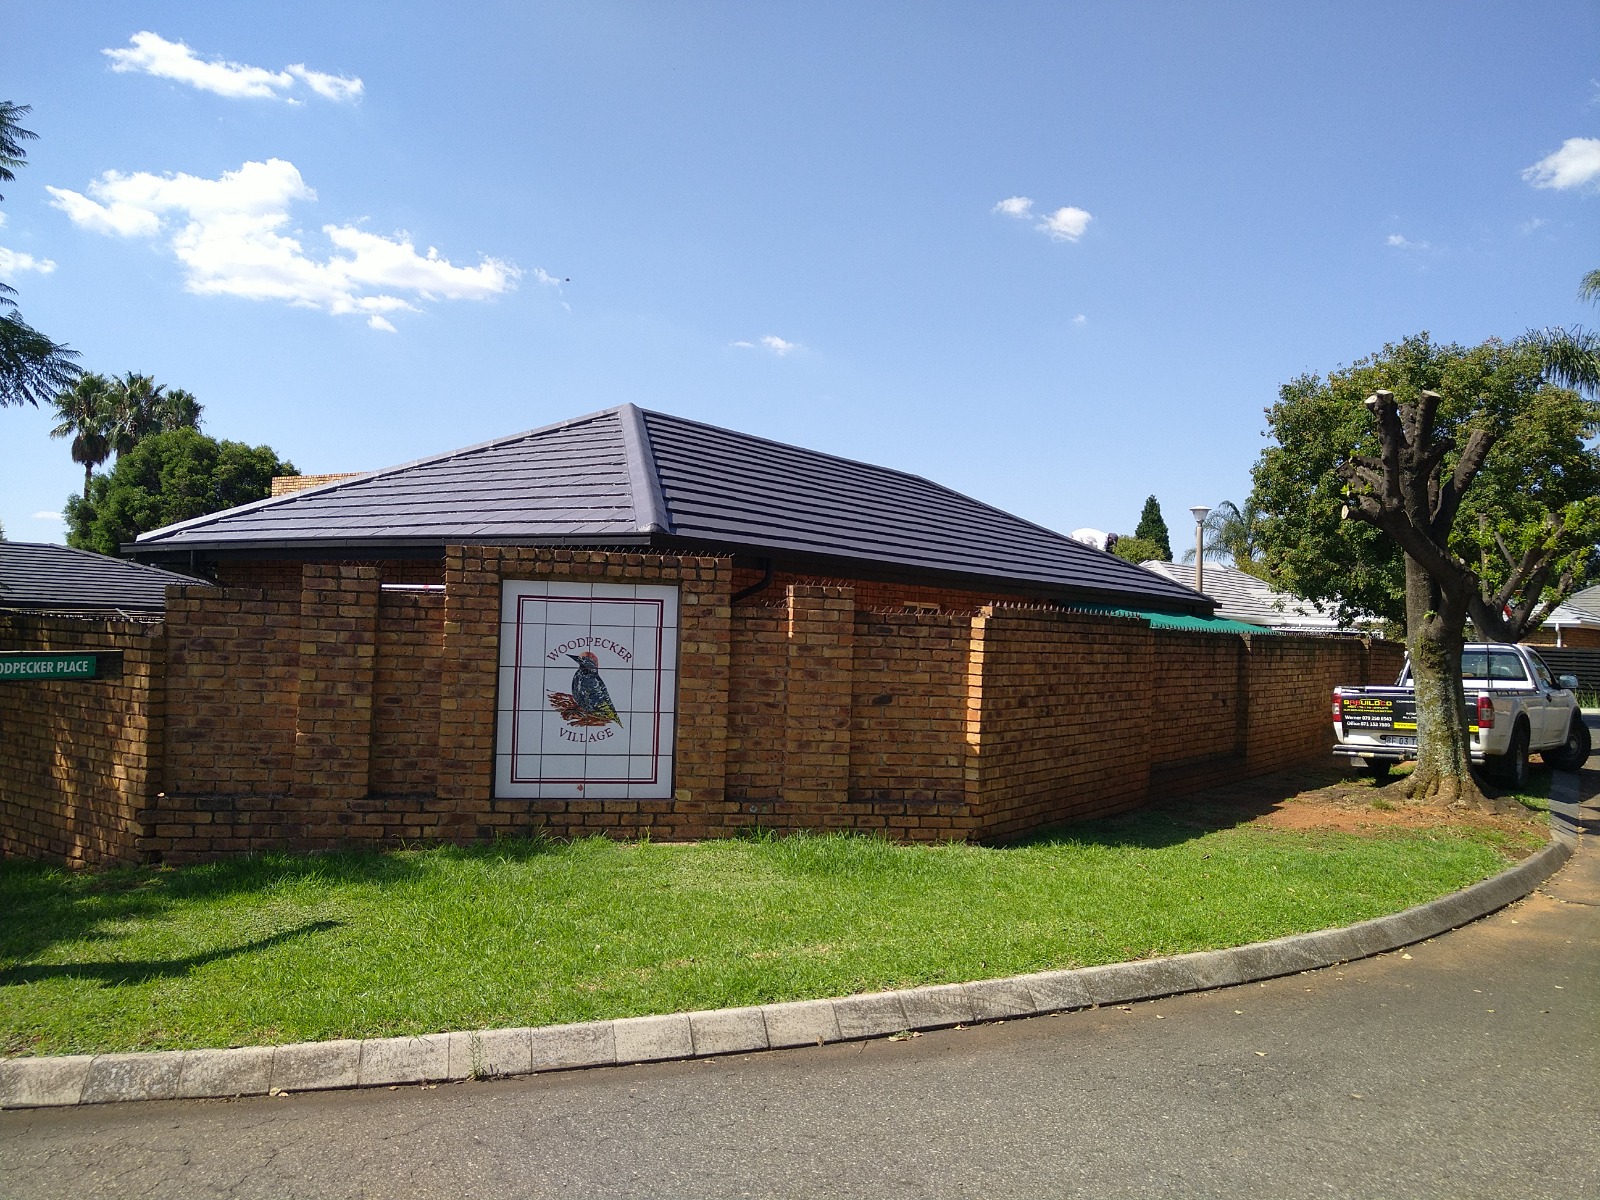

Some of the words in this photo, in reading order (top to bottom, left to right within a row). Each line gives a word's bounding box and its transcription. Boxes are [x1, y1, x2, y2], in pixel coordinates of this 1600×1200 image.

[547, 637, 633, 664] WOODPECKER
[56, 660, 89, 673] PLACE
[559, 727, 614, 743] VILLAGE
[1398, 737, 1409, 745] 03
